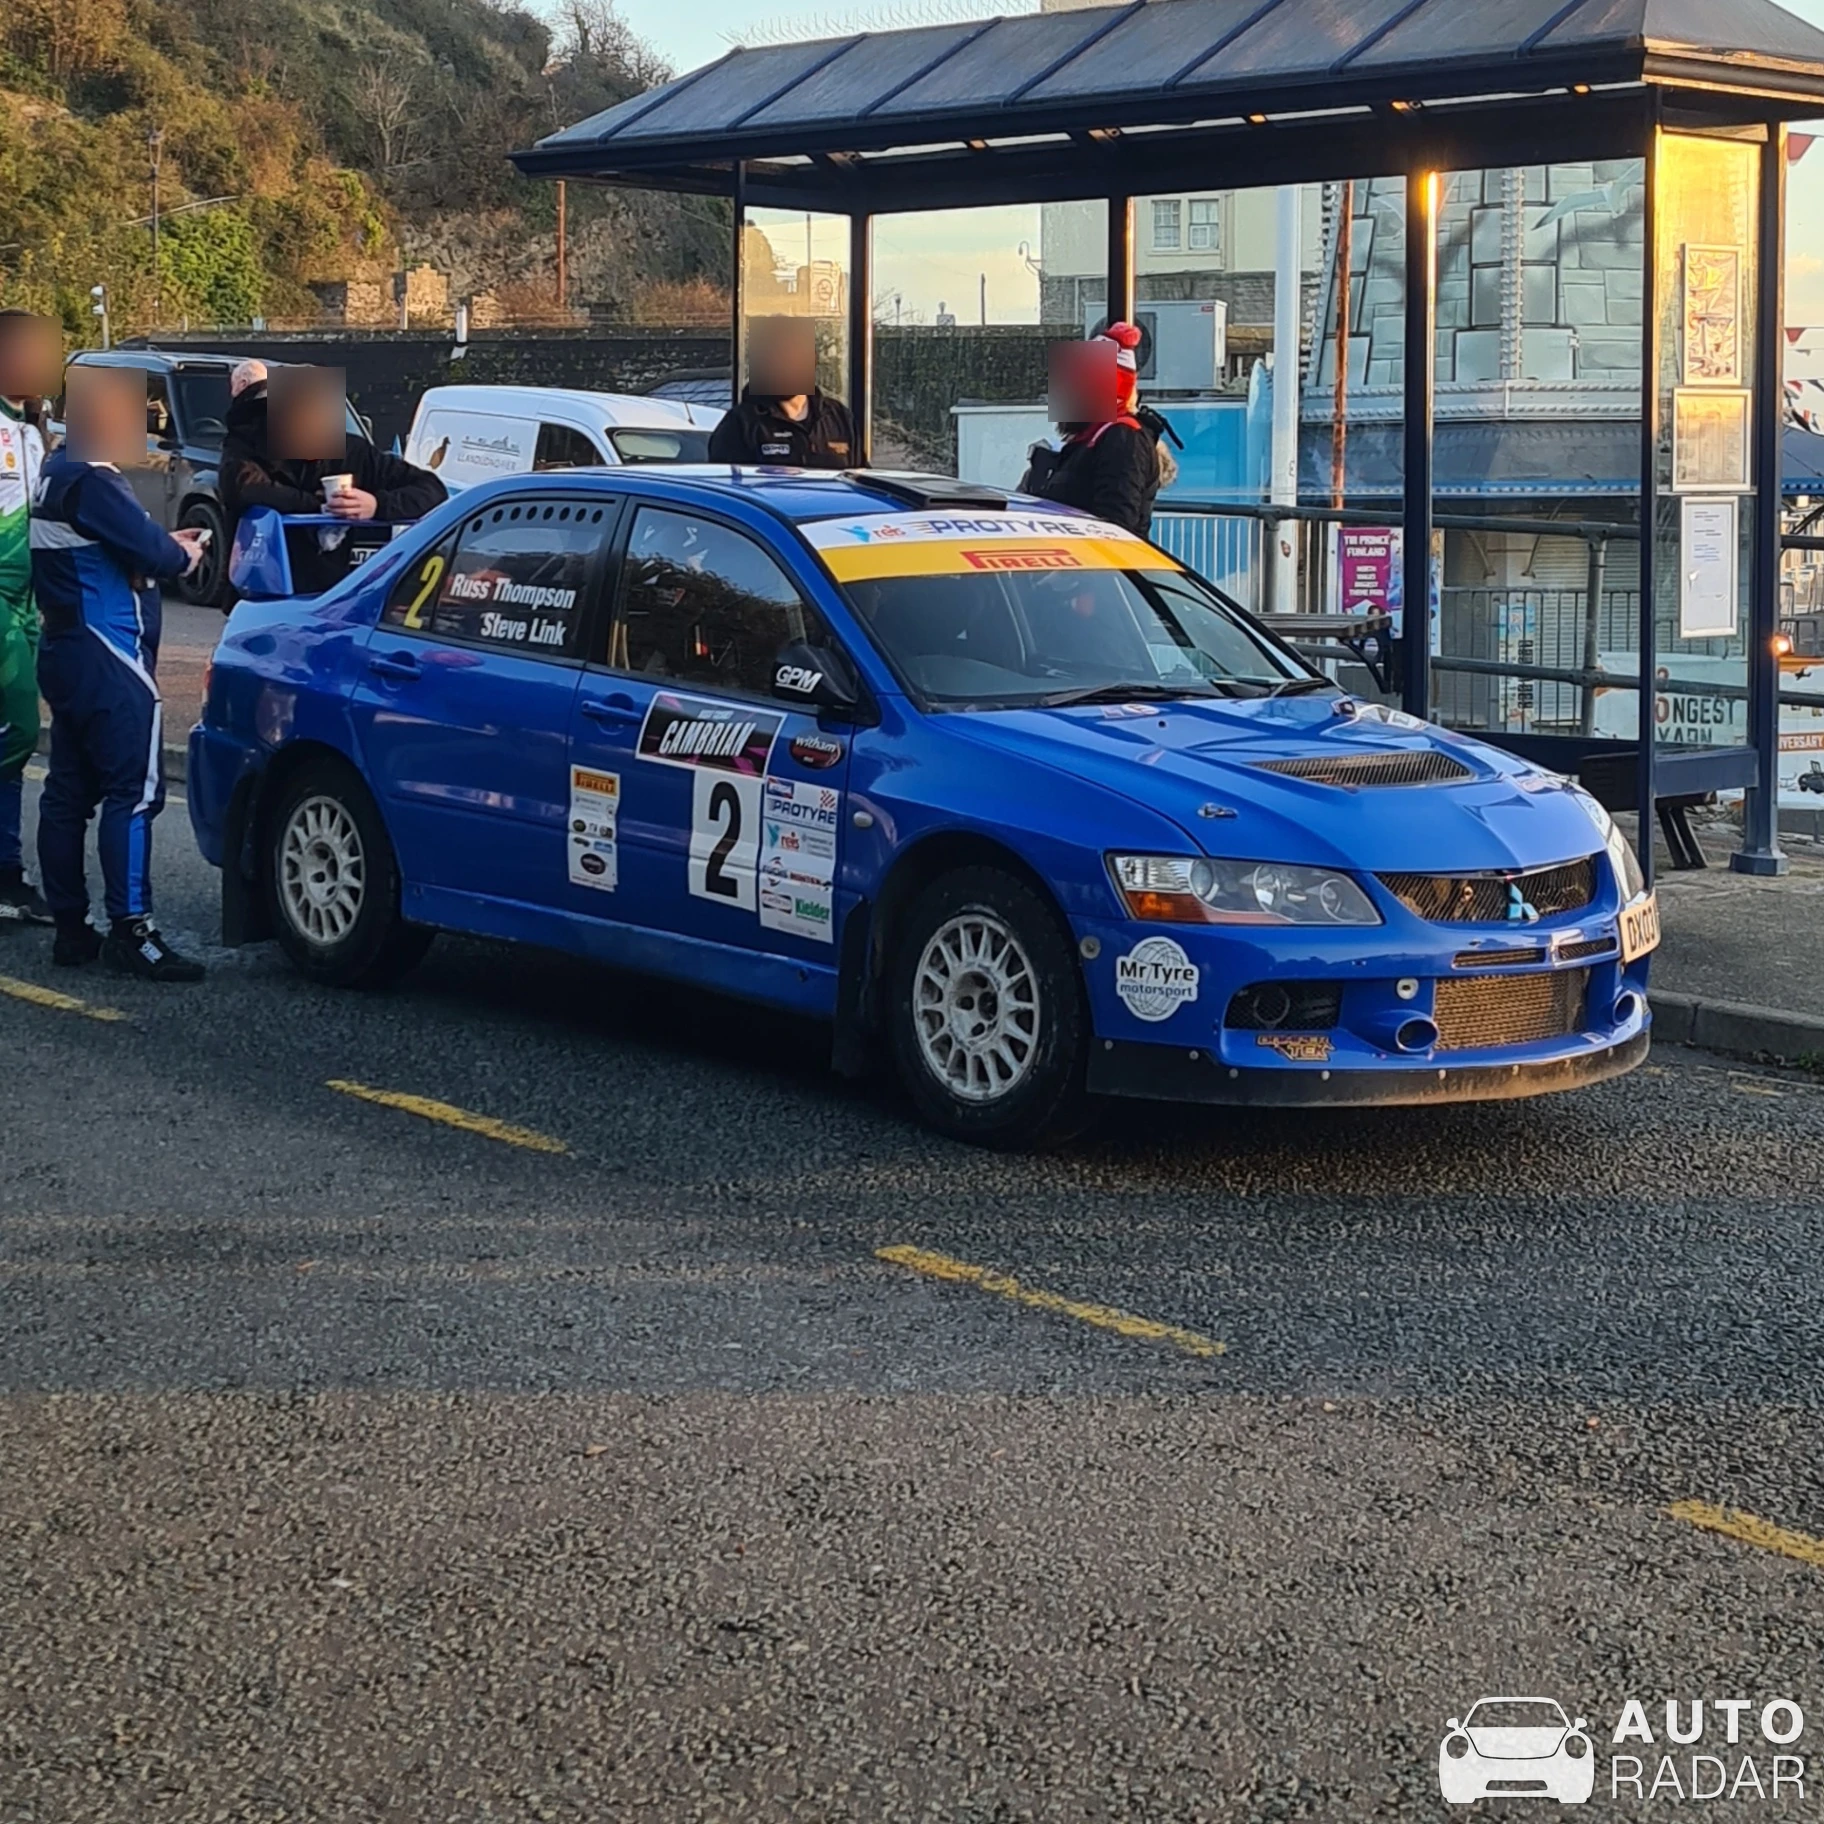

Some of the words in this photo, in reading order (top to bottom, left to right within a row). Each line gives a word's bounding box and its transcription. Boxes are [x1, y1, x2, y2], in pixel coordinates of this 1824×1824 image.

[928, 519, 1087, 536] PROTYRE
[960, 548, 1083, 569] PIRELLI
[404, 556, 445, 629] 2
[450, 573, 491, 599] Russ
[493, 577, 577, 611] Thompson
[480, 612, 527, 641] Steve
[528, 617, 567, 646] Link
[775, 665, 823, 694] GPM
[1655, 696, 1736, 725] ONGEST
[659, 720, 757, 757] CAMBRIAN
[773, 799, 838, 825] PROTYRE
[705, 781, 741, 899] 2
[796, 898, 830, 920] Kielder
[1120, 960, 1147, 978] Mr
[1150, 962, 1195, 985] Tyre
[1120, 984, 1193, 998] motorsport
